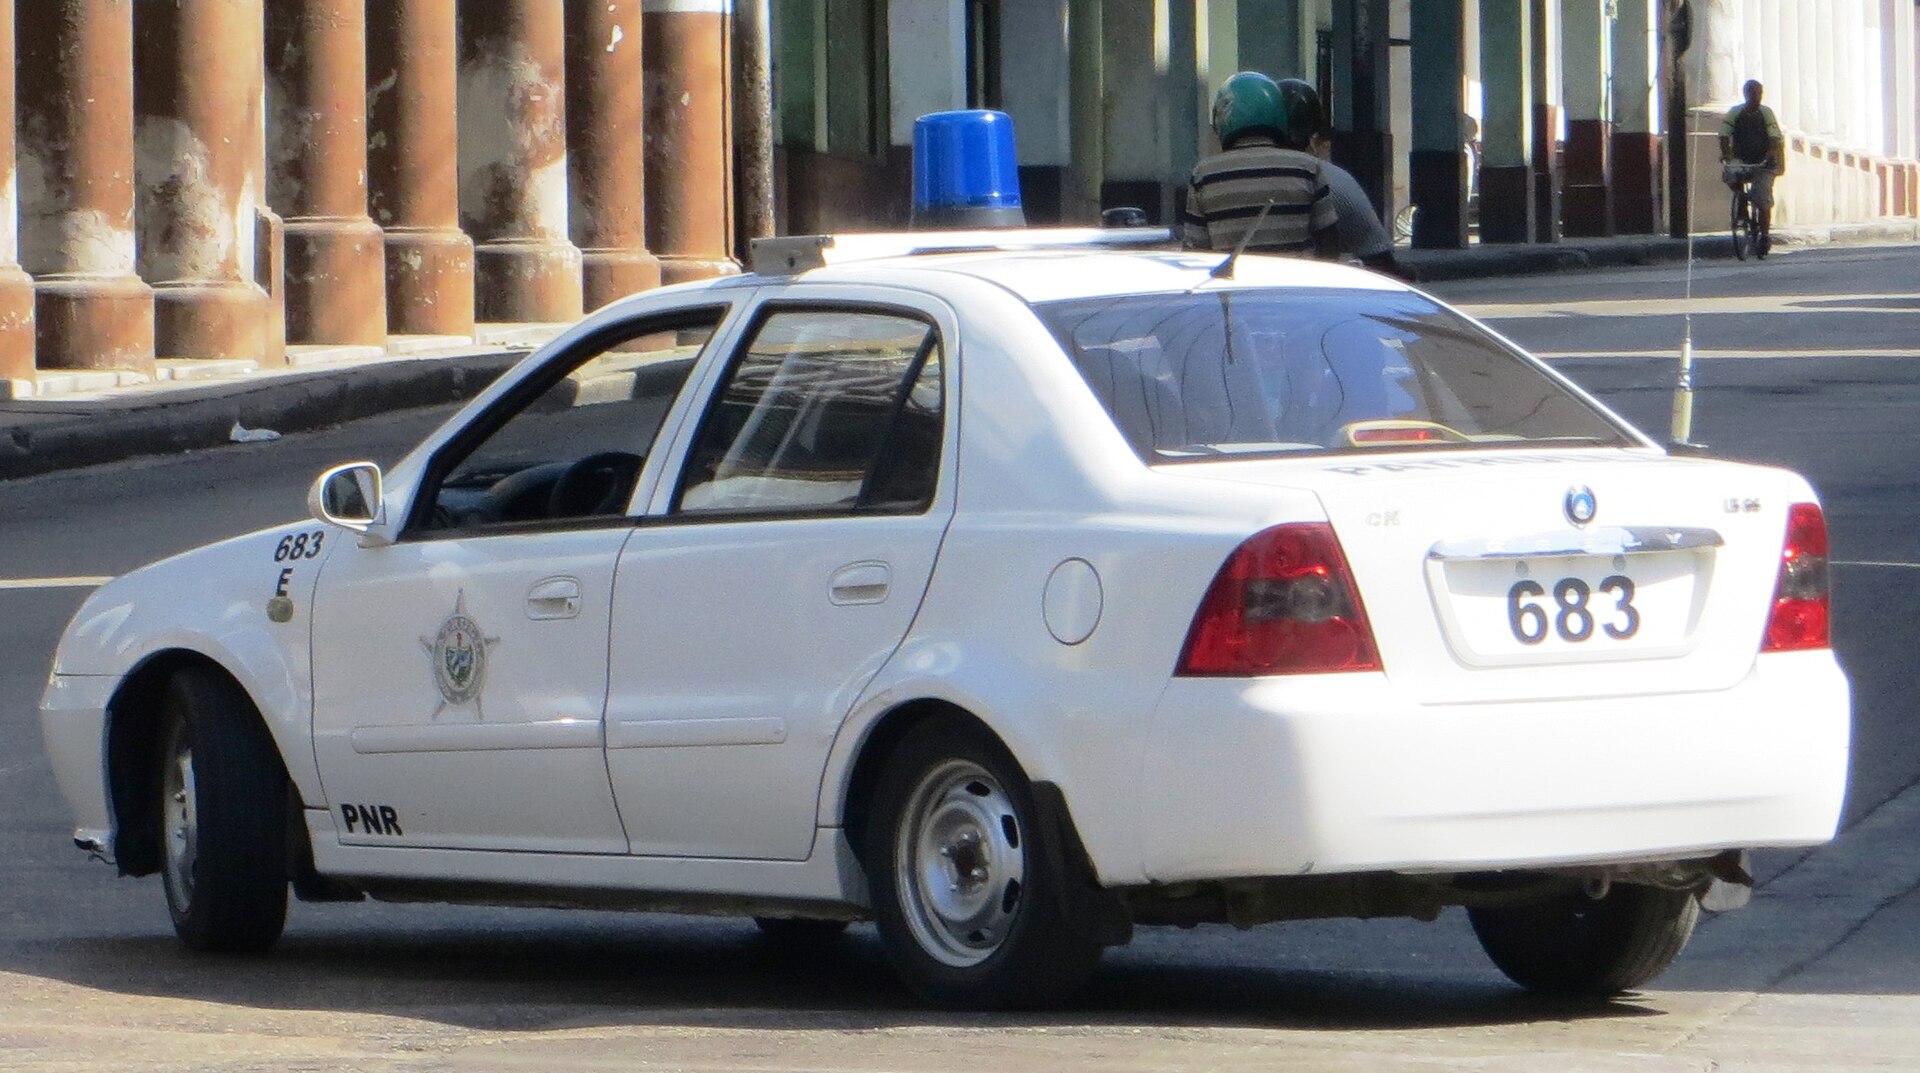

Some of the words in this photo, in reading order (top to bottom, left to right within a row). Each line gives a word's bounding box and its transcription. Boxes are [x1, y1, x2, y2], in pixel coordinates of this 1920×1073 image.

[274, 530, 325, 562] 683
[276, 568, 293, 597] E
[1507, 575, 1641, 646] 683
[341, 803, 402, 837] PNR
